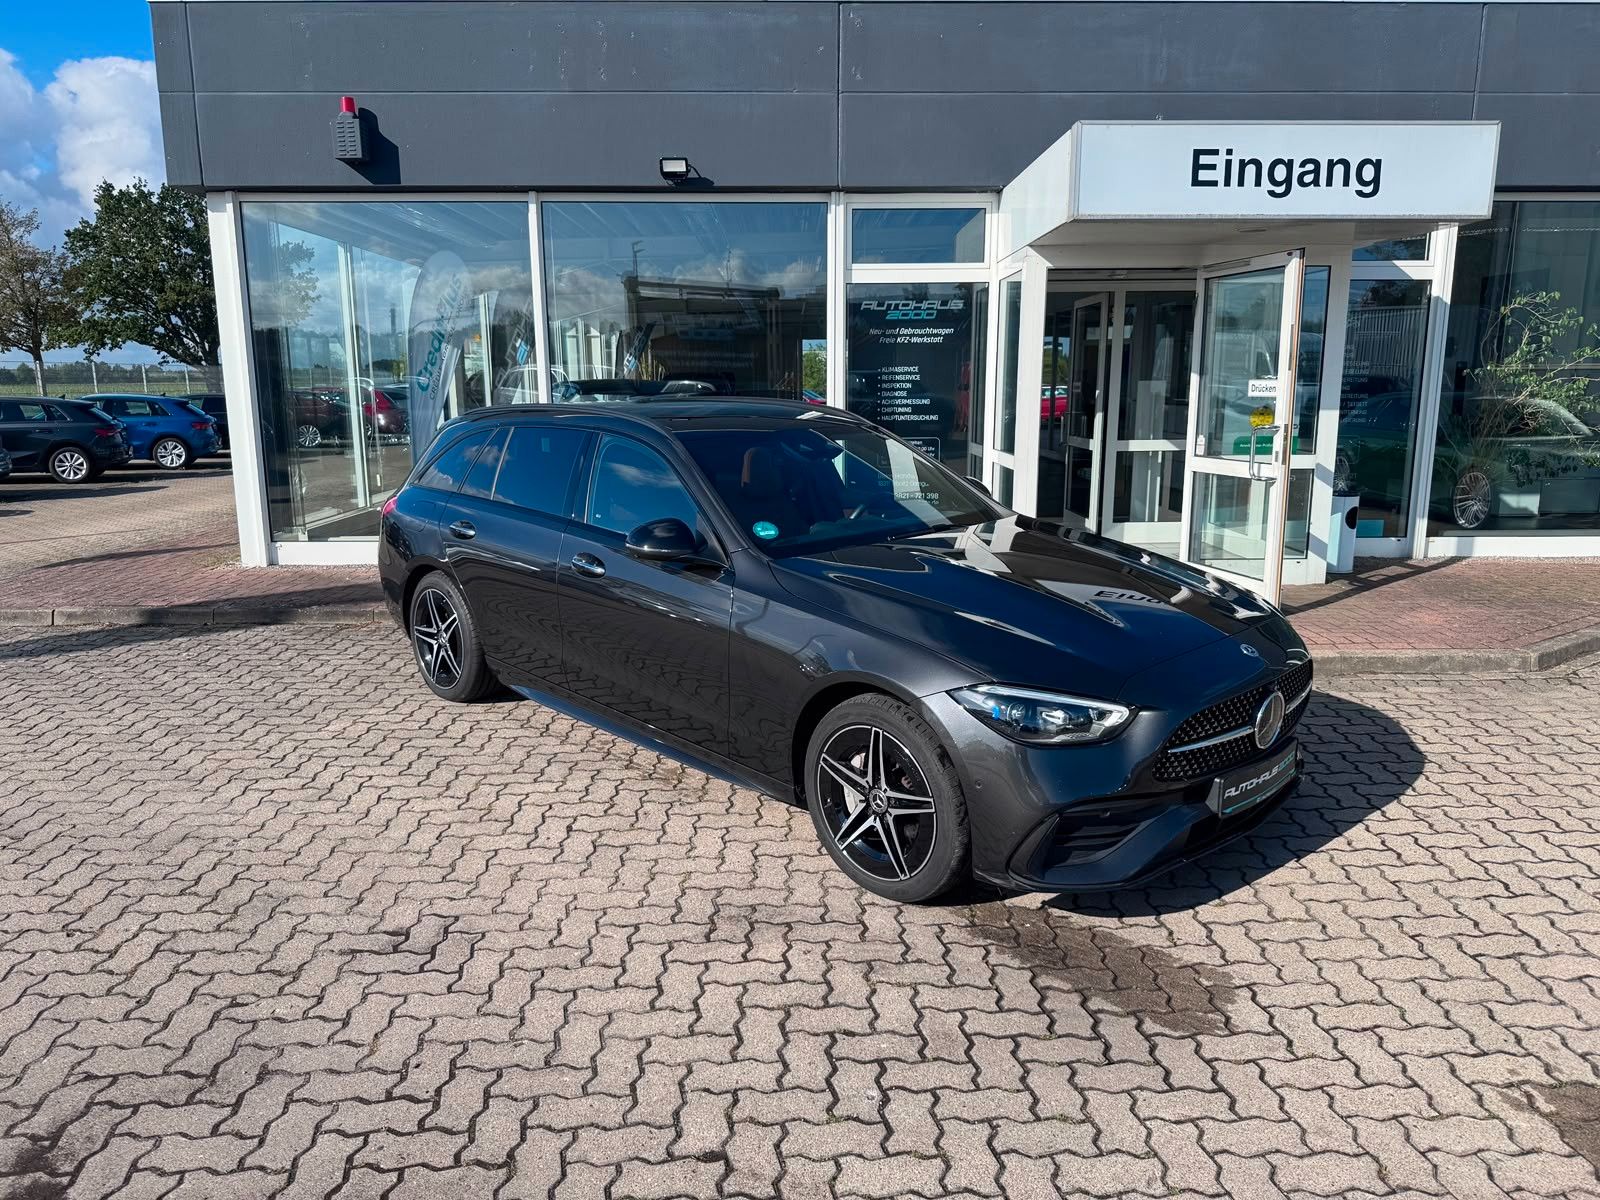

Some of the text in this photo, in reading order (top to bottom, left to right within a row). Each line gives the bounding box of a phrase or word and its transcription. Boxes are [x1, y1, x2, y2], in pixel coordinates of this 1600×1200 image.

[1190, 148, 1383, 199] Eingang
[860, 299, 965, 310] AUTOHAUS
[885, 310, 937, 320] 2000
[899, 327, 954, 336] Gebrauchtwagen
[879, 336, 944, 344] Freie KFZ-Werkstatt
[1250, 383, 1277, 393] Drücken
[1223, 764, 1280, 800] AUTOHAUS
